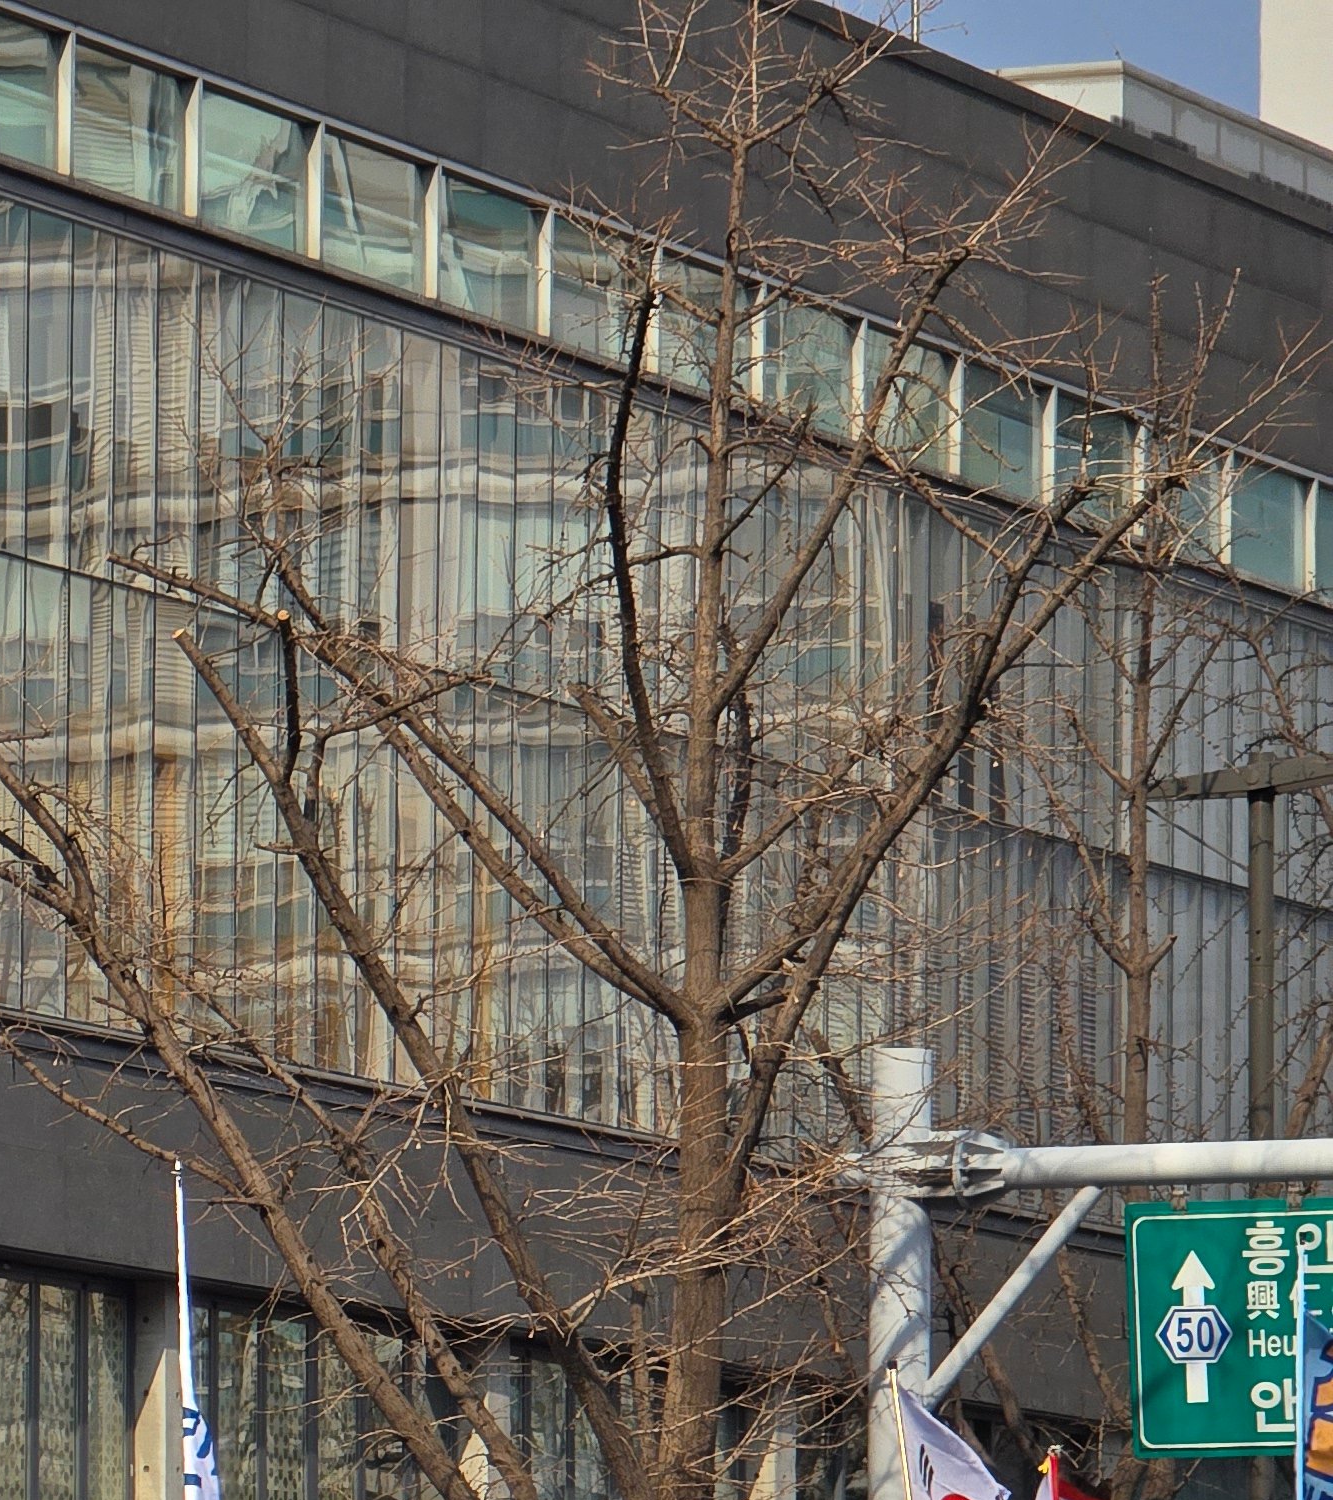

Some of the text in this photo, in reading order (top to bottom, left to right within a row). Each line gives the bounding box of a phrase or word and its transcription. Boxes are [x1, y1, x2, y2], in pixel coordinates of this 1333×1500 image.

[1176, 1316, 1215, 1354] 50
[1247, 1328, 1297, 1358] Heu
[1249, 1380, 1297, 1433] 안
